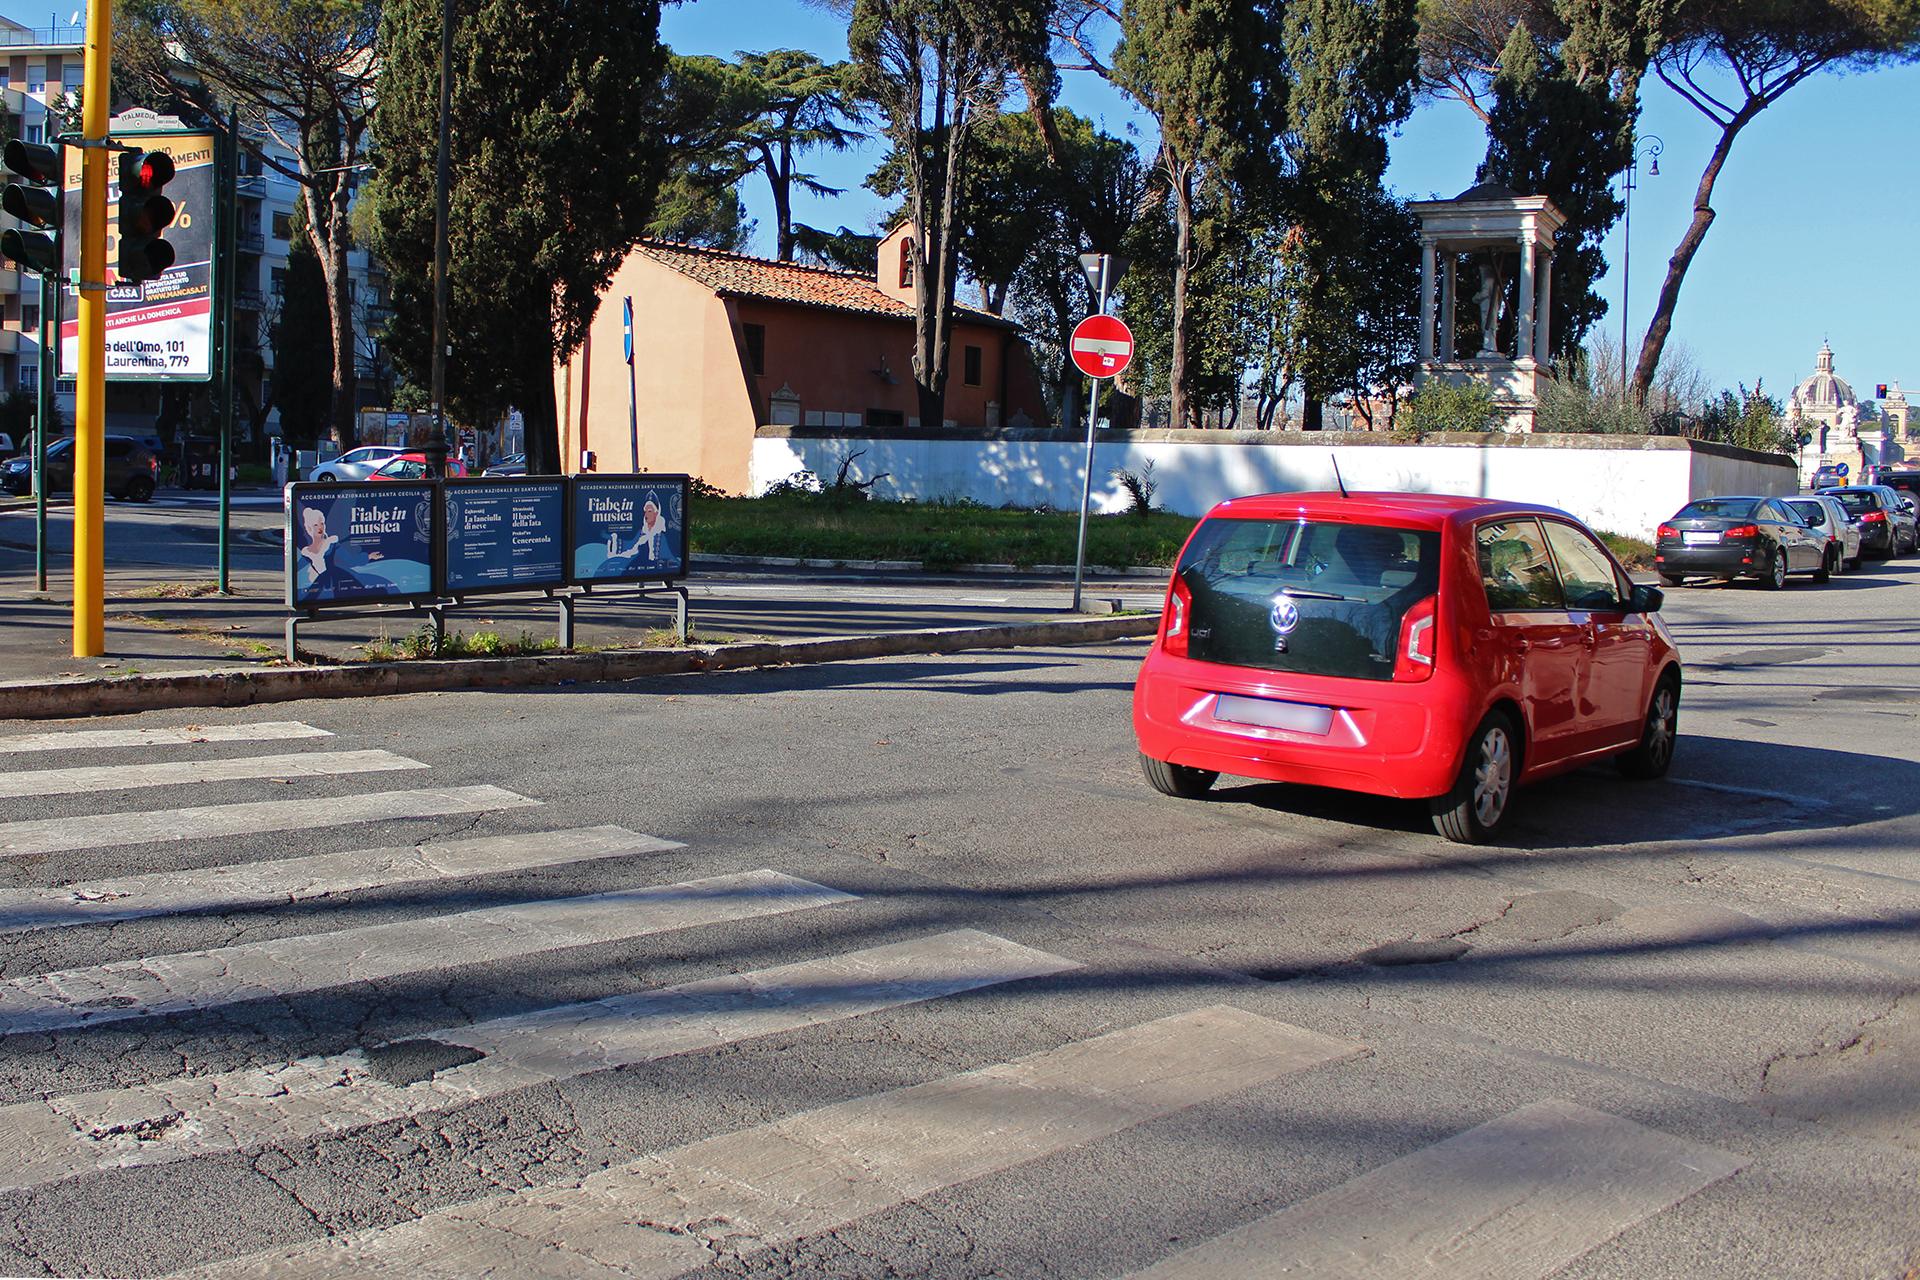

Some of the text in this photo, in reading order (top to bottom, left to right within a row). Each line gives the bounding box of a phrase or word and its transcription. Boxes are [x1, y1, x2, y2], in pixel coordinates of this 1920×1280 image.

[121, 112, 156, 122] ITALMEDIA
[145, 277, 189, 289] APPUNTAMENTO
[110, 288, 139, 298] CASA
[145, 286, 172, 295] GRATUITO
[145, 285, 208, 302] WWW.MANCASA.IT
[115, 315, 137, 325] ANCHE
[137, 313, 147, 322] LA
[146, 307, 182, 320] DOMENICA
[113, 340, 164, 354] dell'Omo,
[166, 340, 185, 352] 101
[107, 355, 190, 368] Laurentina, 779
[588, 497, 634, 512] Fiabe in
[351, 505, 407, 522] Fiabe in
[464, 514, 502, 523] La fanciulla
[592, 510, 633, 523] musica
[350, 520, 401, 535] musica
[512, 519, 542, 528] della fata
[512, 535, 551, 545] Cenerentola
